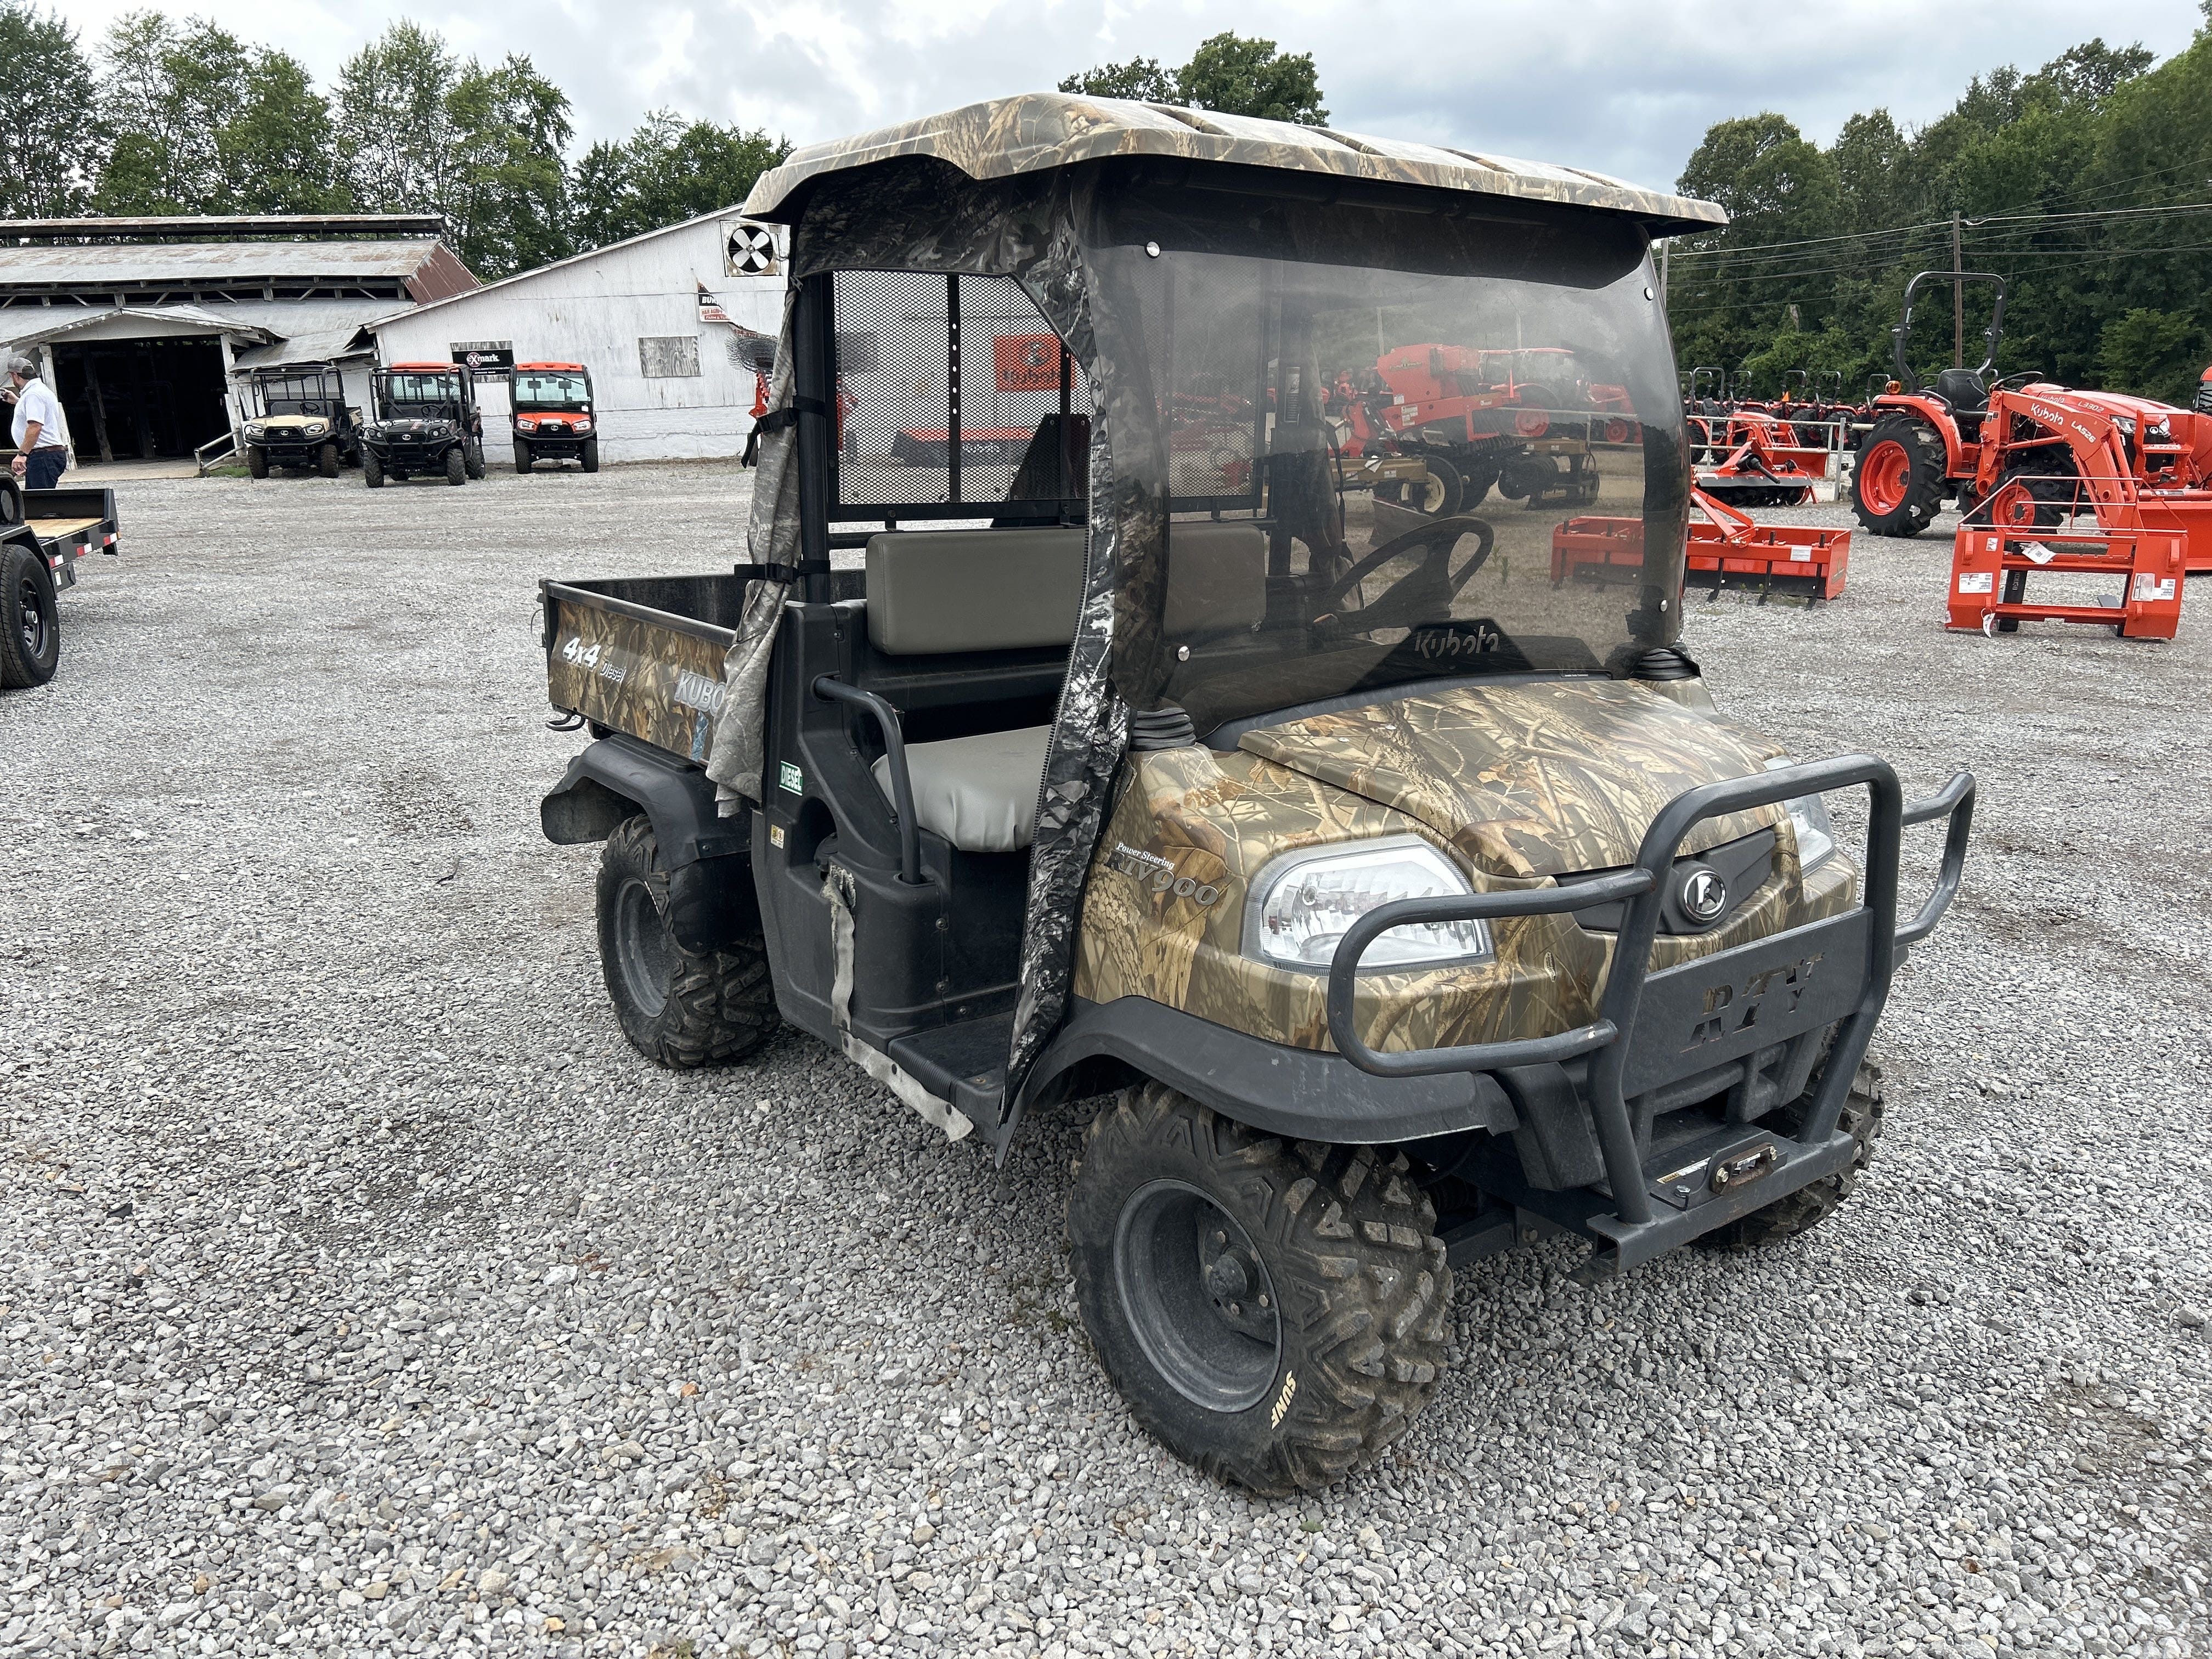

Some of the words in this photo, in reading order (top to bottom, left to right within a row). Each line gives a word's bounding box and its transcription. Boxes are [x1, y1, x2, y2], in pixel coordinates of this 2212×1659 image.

[2031, 403, 2064, 426] Kubota
[2077, 400, 2105, 413] L3302
[1414, 625, 1499, 659] Kubota
[563, 637, 602, 673] 4x4
[600, 660, 627, 686] Diesel
[674, 668, 726, 716] KUBO
[781, 765, 802, 791] DIESEL
[1116, 842, 1142, 856] Power
[1141, 850, 1176, 870] Steering
[1103, 849, 1219, 906] RTV900
